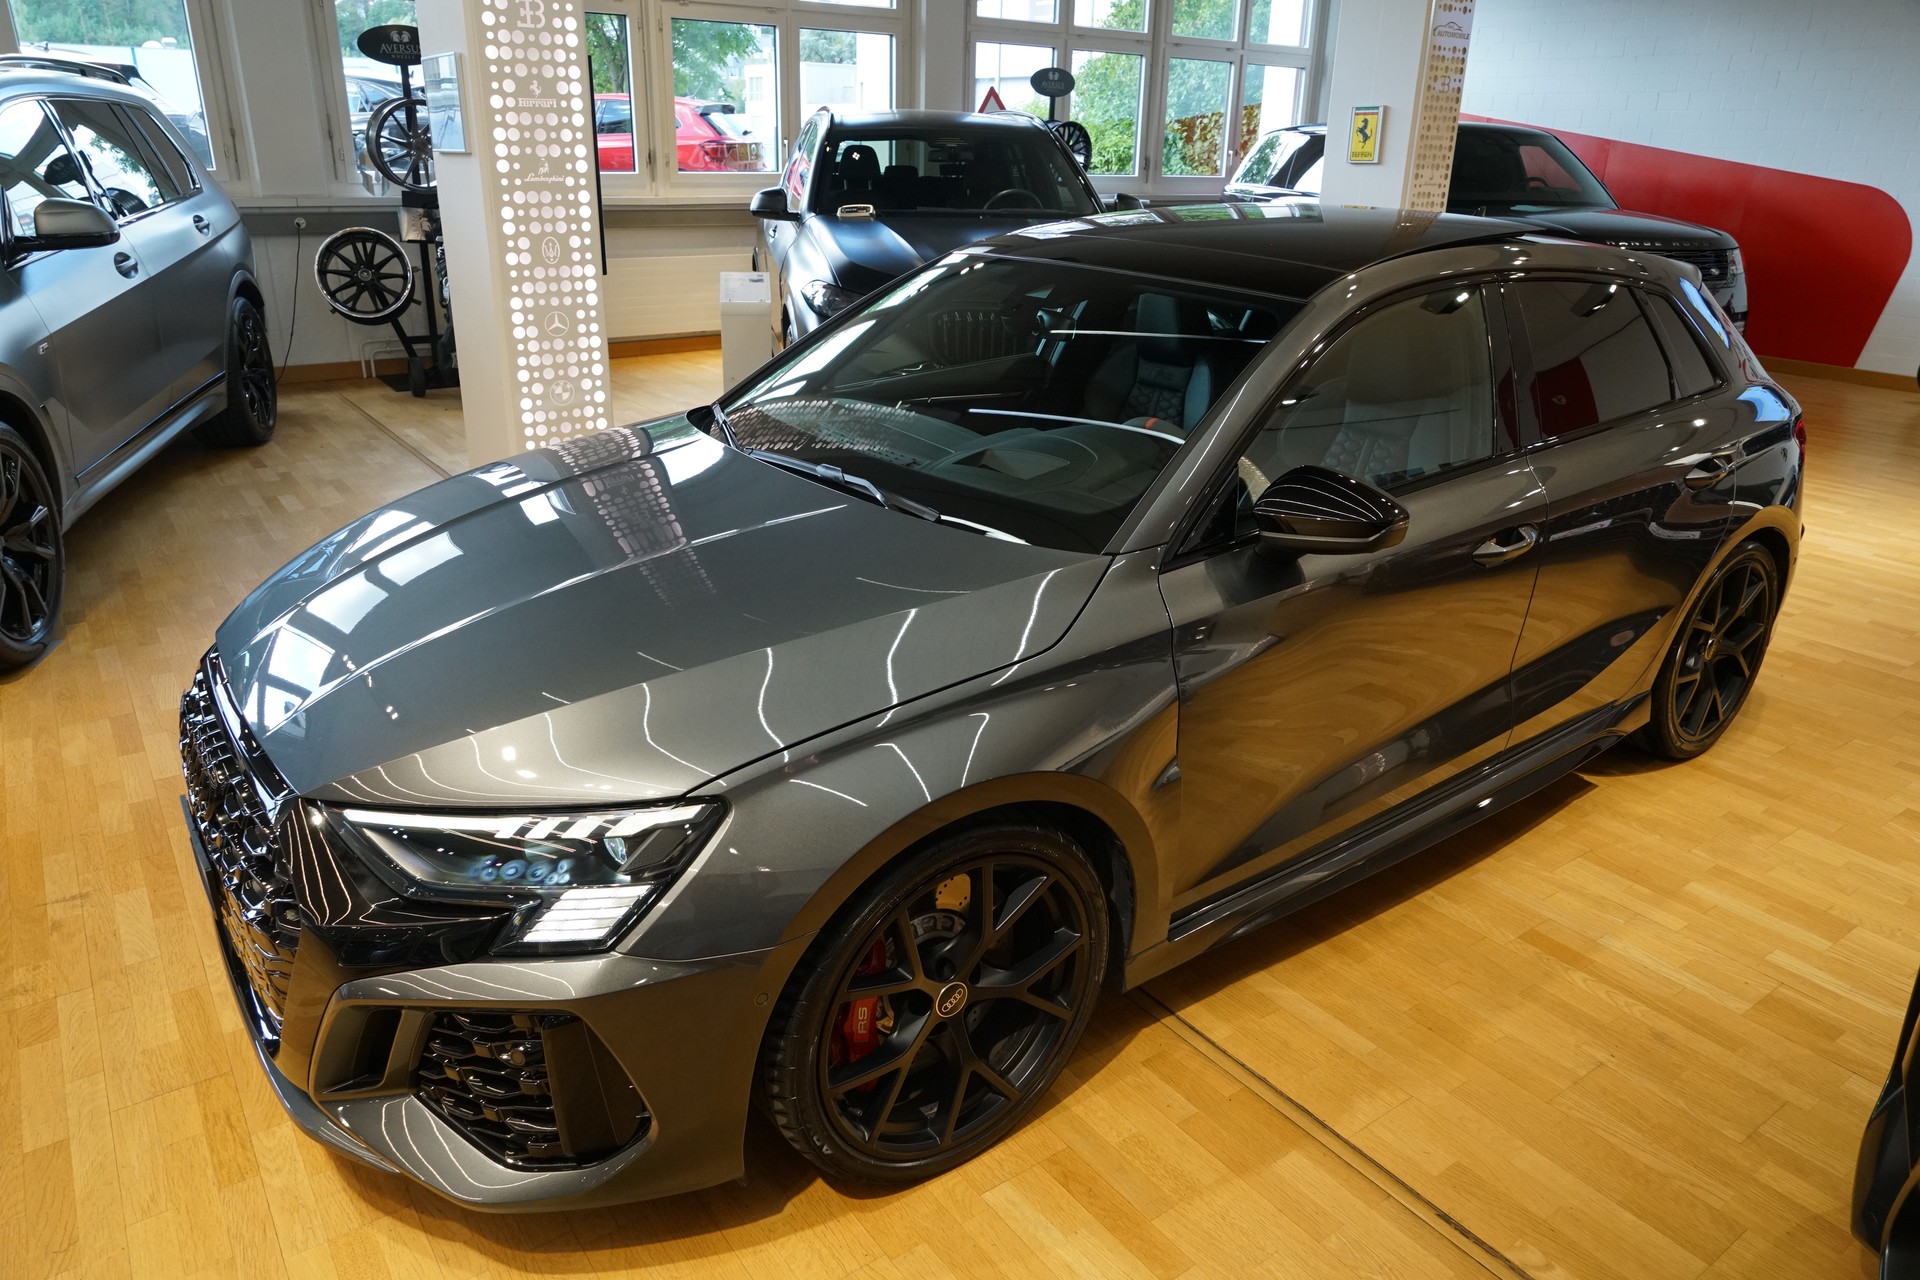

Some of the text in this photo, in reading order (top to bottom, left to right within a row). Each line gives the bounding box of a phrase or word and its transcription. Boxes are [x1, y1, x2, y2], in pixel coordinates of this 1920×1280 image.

[380, 43, 421, 55] AVERSU
[517, 97, 557, 108] Ferrari
[524, 172, 564, 184] Lamborghini
[857, 1007, 868, 1034] RS
